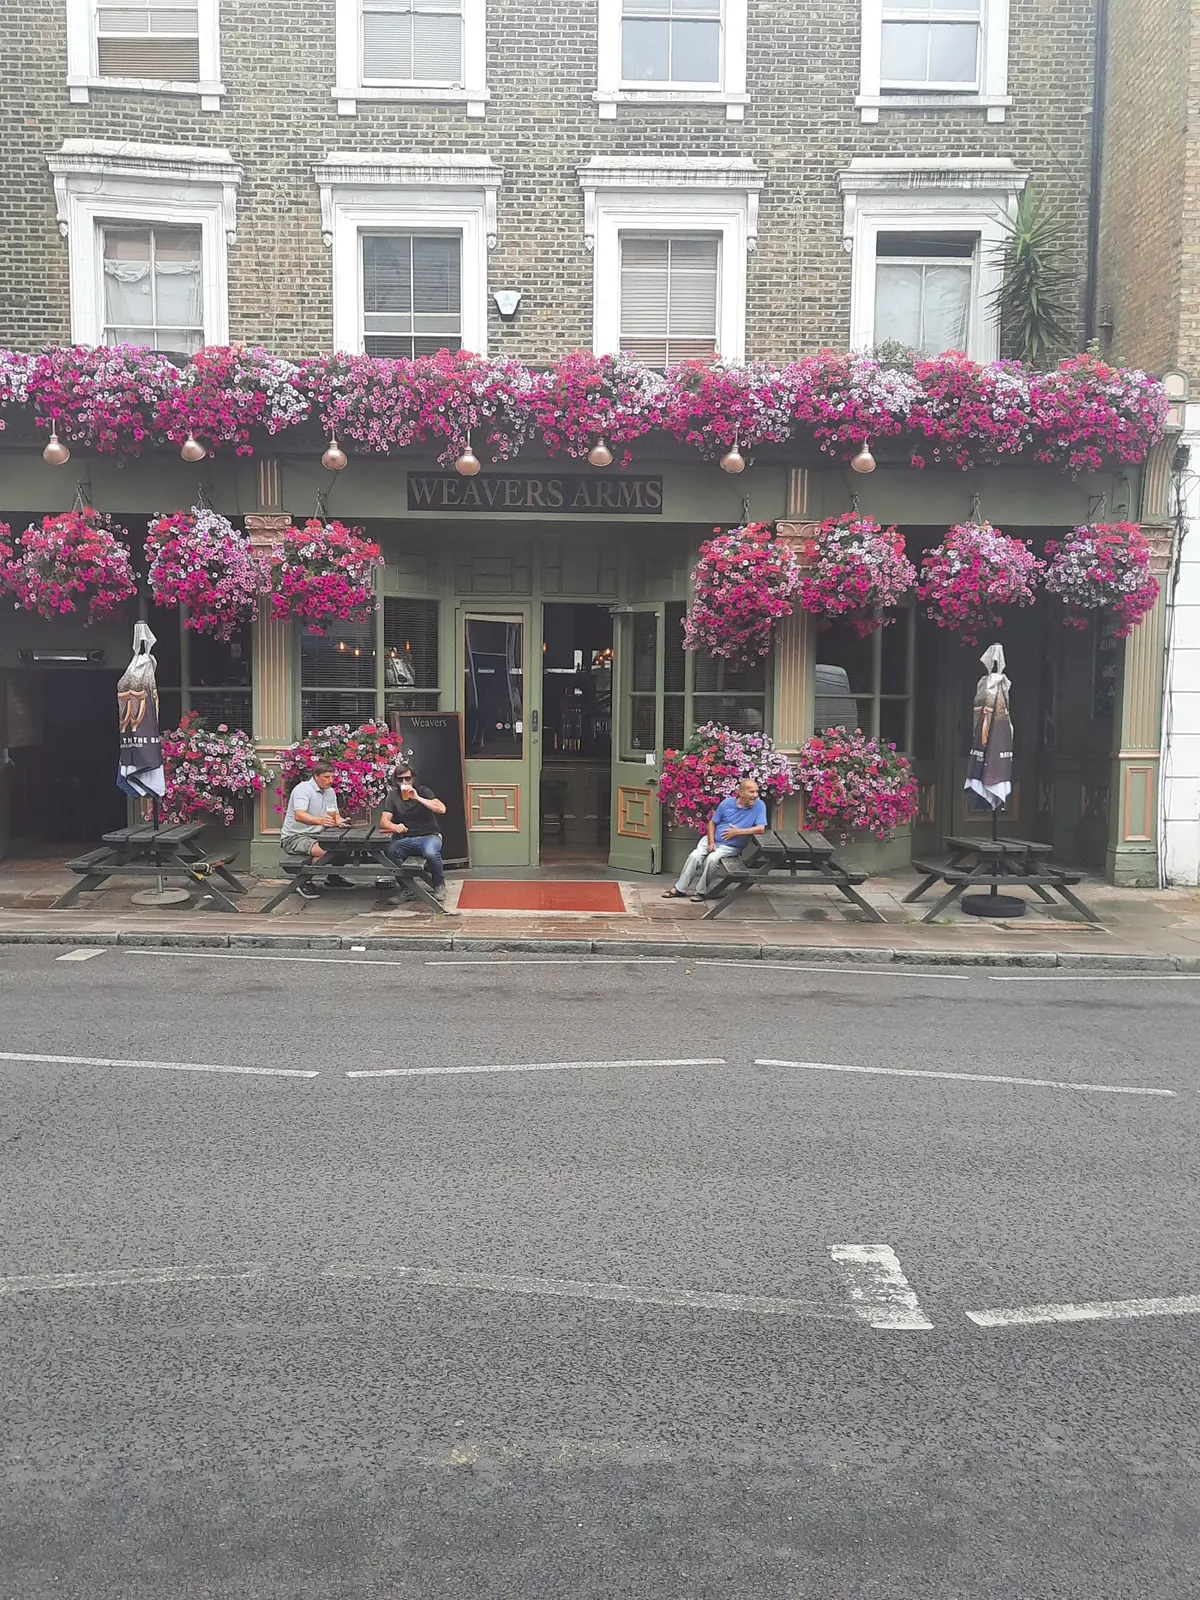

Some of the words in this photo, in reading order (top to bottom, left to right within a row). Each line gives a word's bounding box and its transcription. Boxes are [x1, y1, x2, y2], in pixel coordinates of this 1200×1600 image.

[408, 477, 564, 508] WEAVERS
[571, 480, 662, 509] ARMS
[411, 717, 447, 727] Weavers
